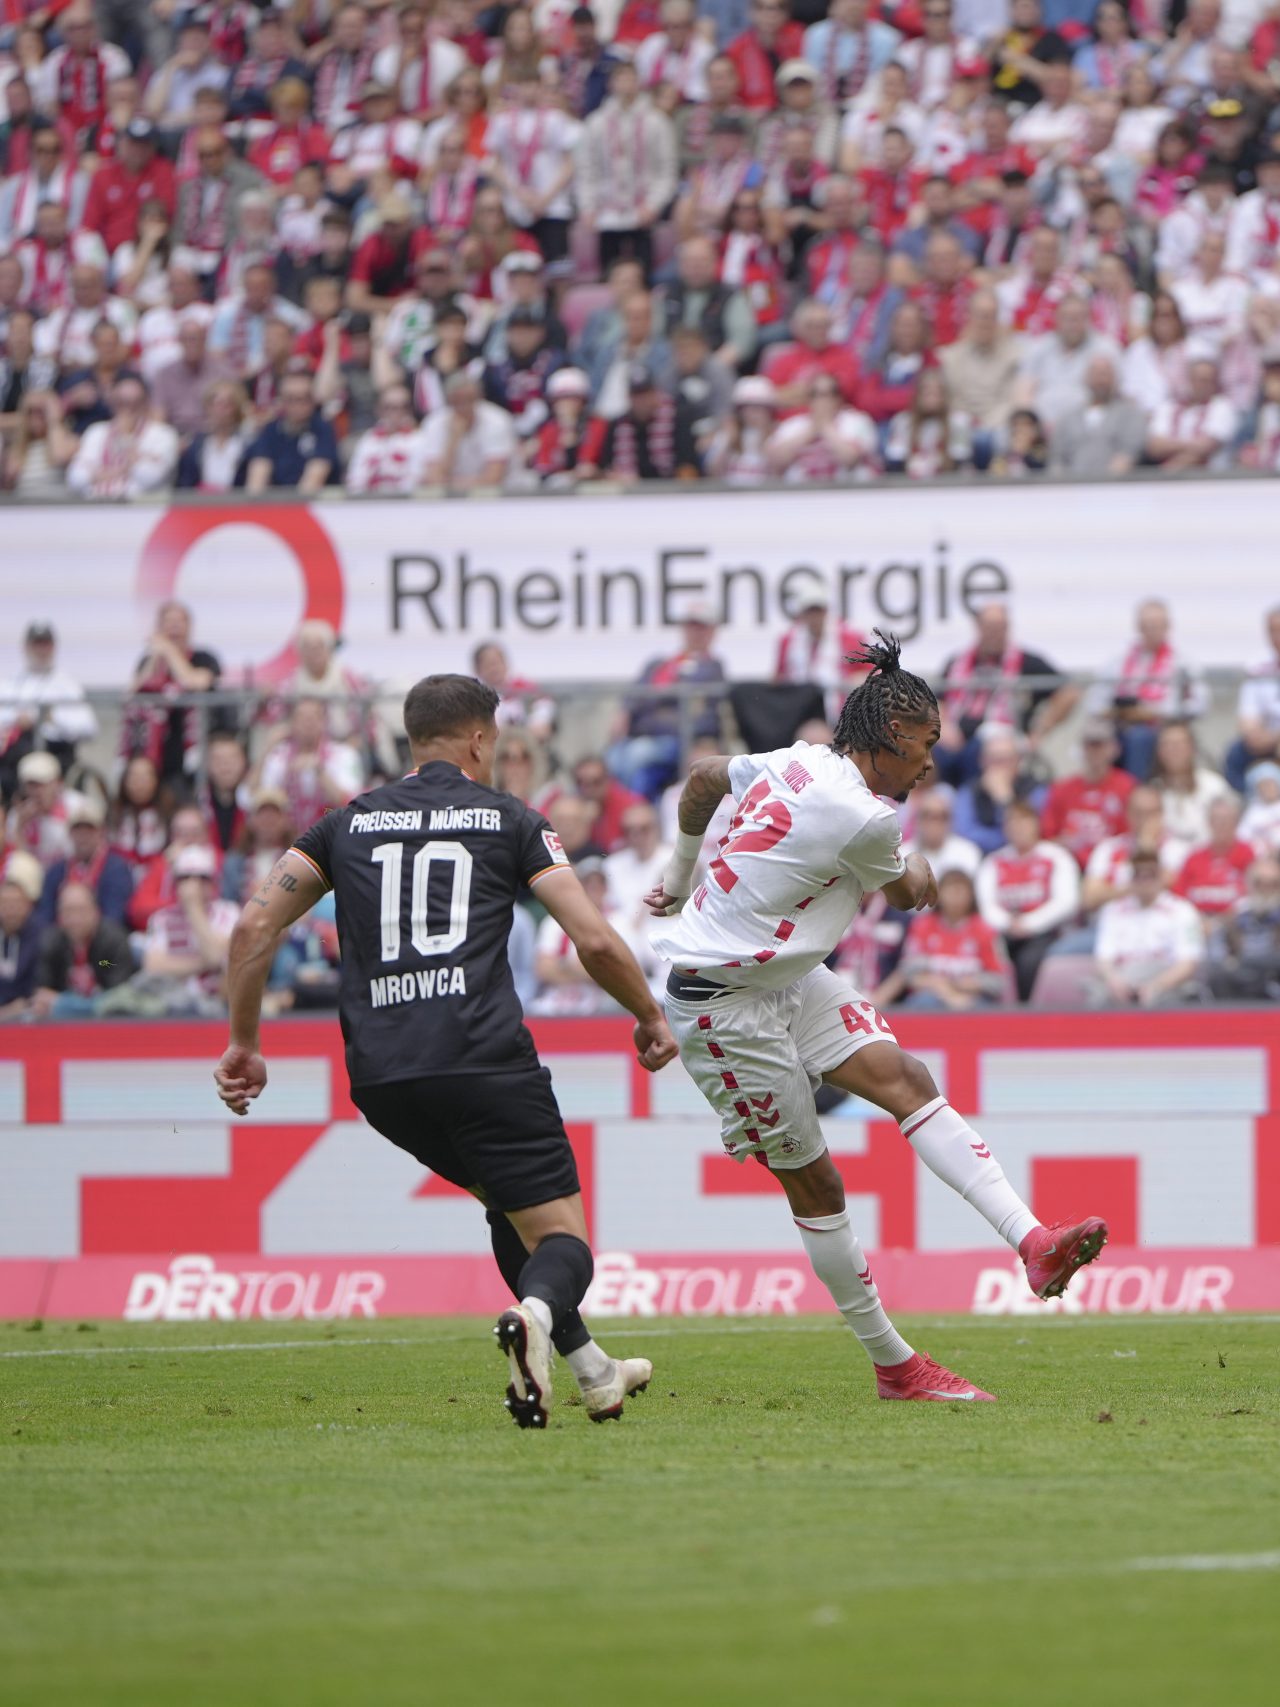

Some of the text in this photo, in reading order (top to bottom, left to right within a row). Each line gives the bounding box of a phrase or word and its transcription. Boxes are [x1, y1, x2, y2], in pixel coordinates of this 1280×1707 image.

[390, 541, 1010, 642] RheinEnergie
[349, 806, 501, 833] PREUSSEN MÜNSTER
[371, 840, 473, 962] 10
[370, 966, 466, 1008] MROWCA
[123, 1255, 386, 1321] DERTOUR
[583, 1252, 806, 1317] ERTOUR
